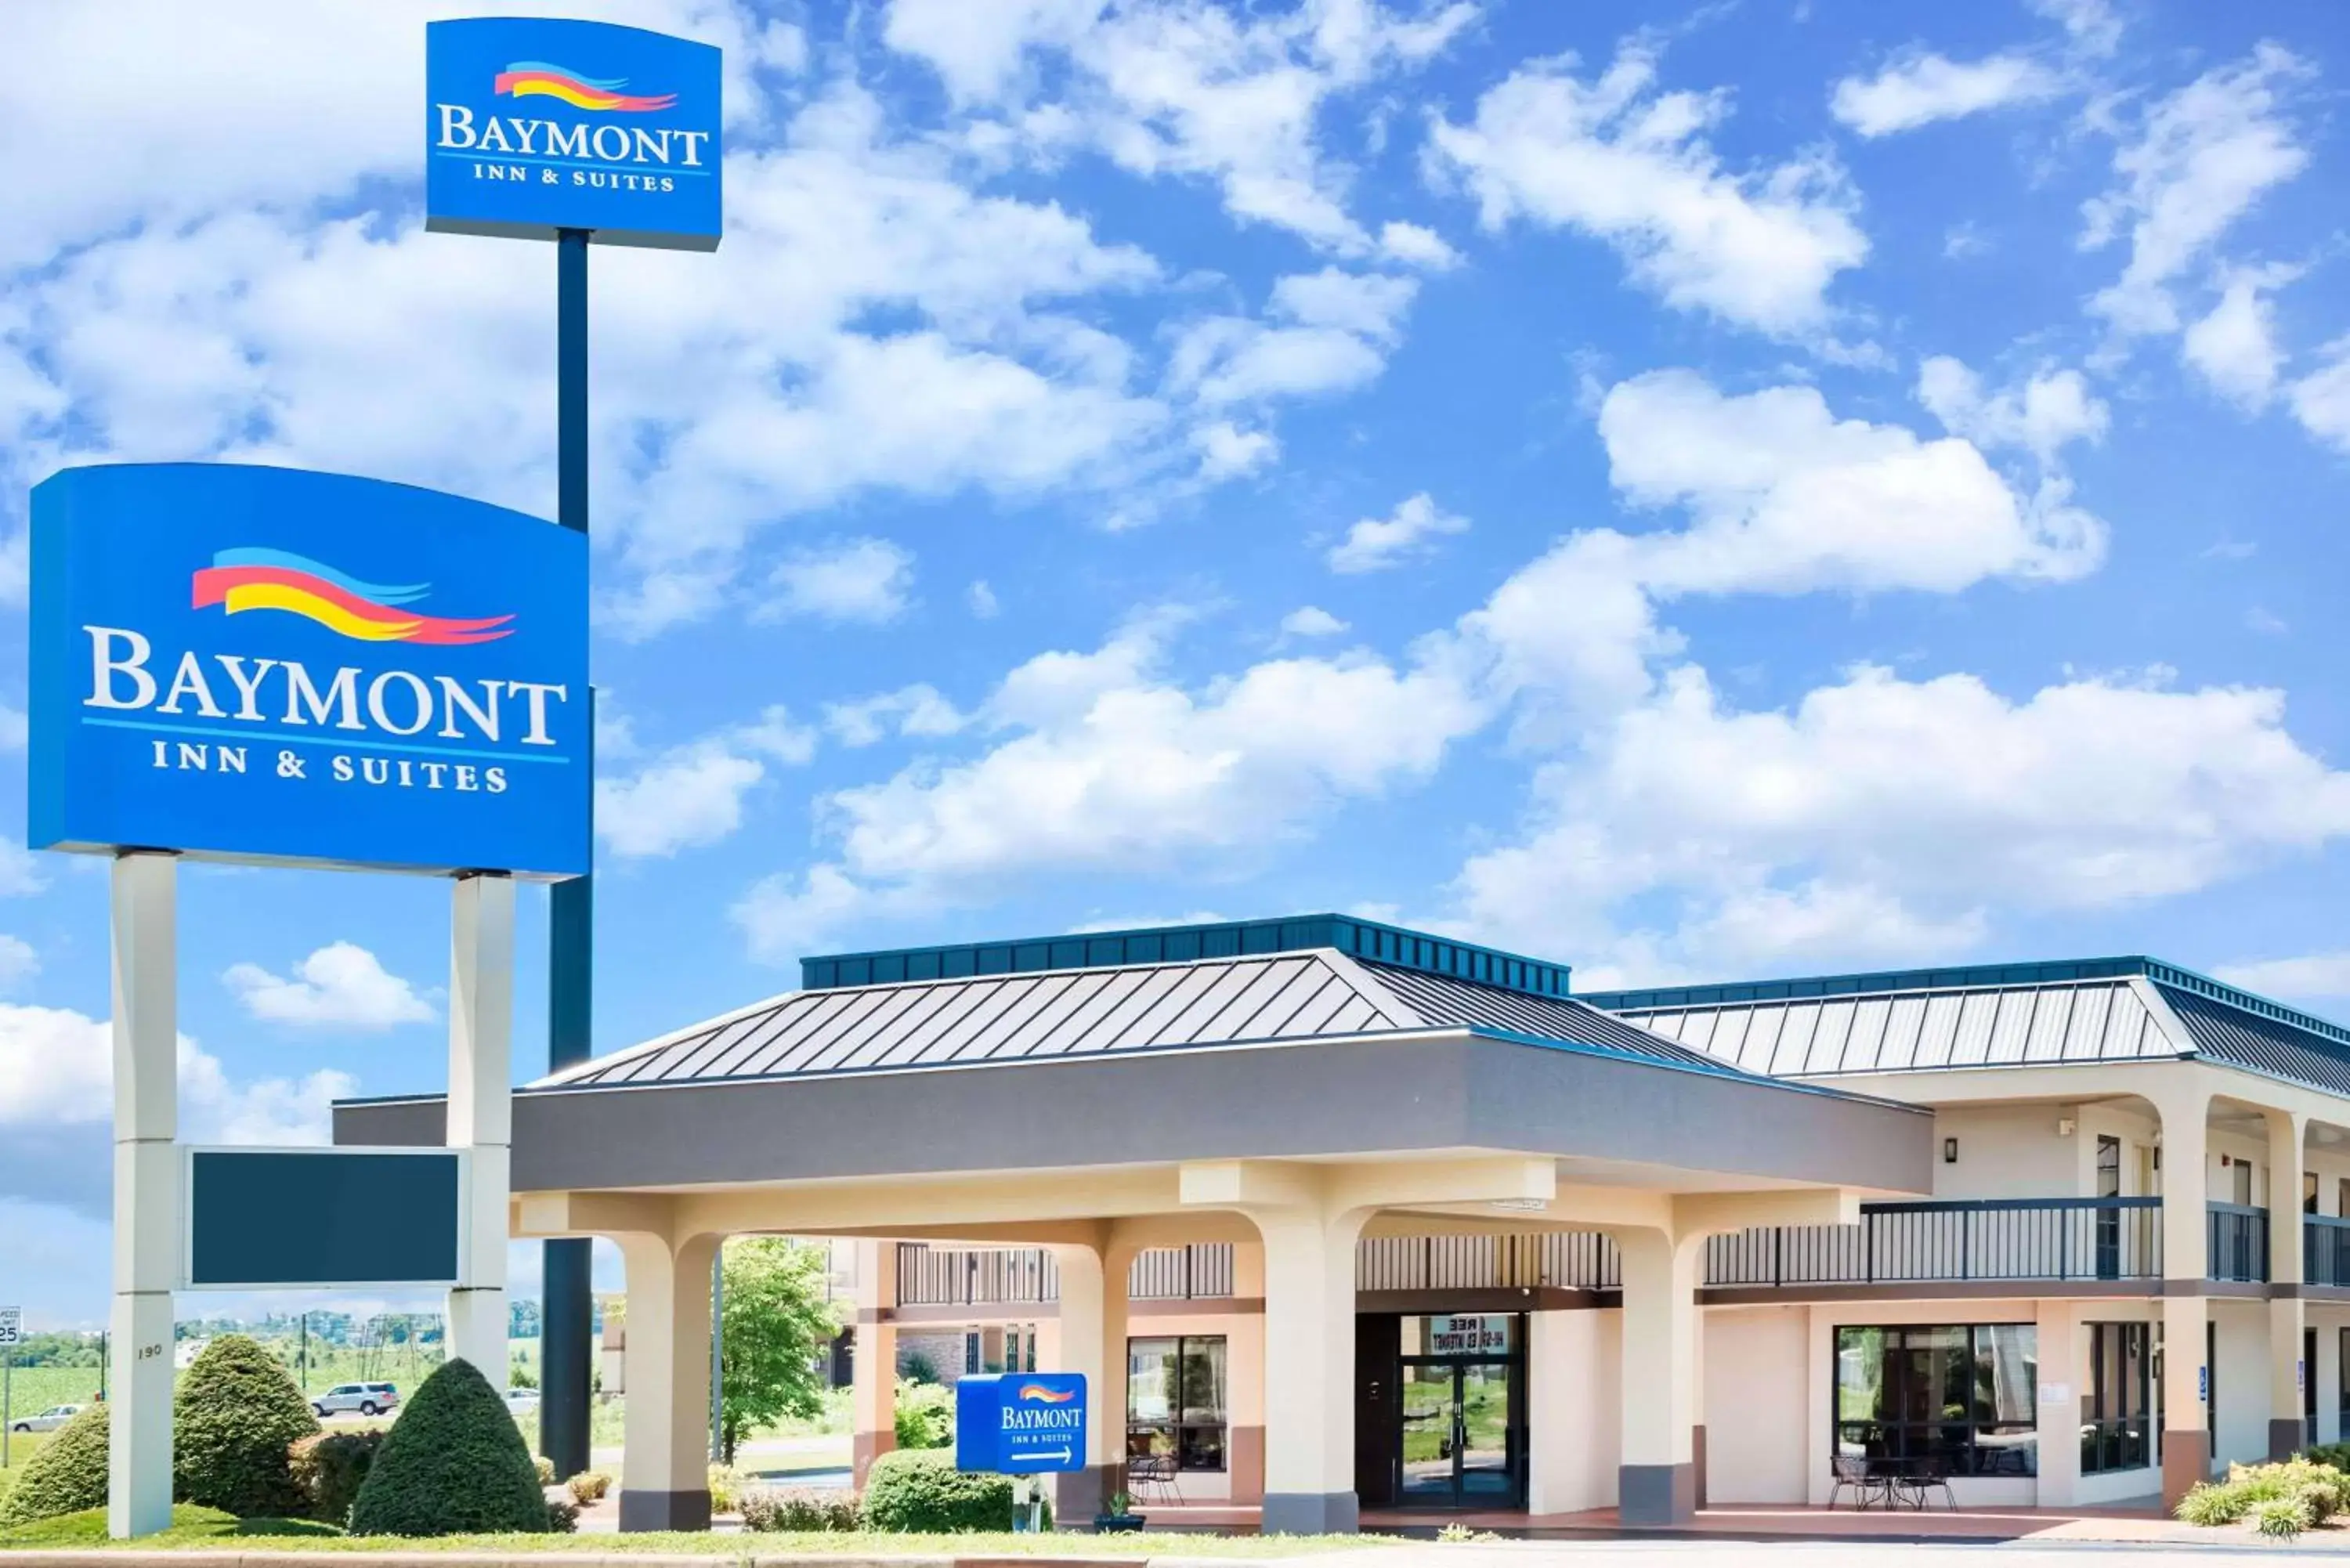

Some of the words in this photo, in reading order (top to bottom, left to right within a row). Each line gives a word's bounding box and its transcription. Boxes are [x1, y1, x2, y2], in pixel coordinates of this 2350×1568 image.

[436, 103, 708, 166] BAYMONT
[473, 164, 526, 181] INN
[541, 168, 558, 184] &
[573, 172, 674, 192] SUITES
[82, 625, 567, 746] BAYMONT
[152, 740, 248, 773] INN
[277, 750, 306, 779] &
[332, 756, 507, 793] SUITES
[0, 1328, 17, 1342] 25
[139, 1344, 162, 1360] 190
[1001, 1406, 1083, 1429] BAYMONT
[1011, 1435, 1029, 1443] INN
[1041, 1433, 1073, 1443] SUITES
